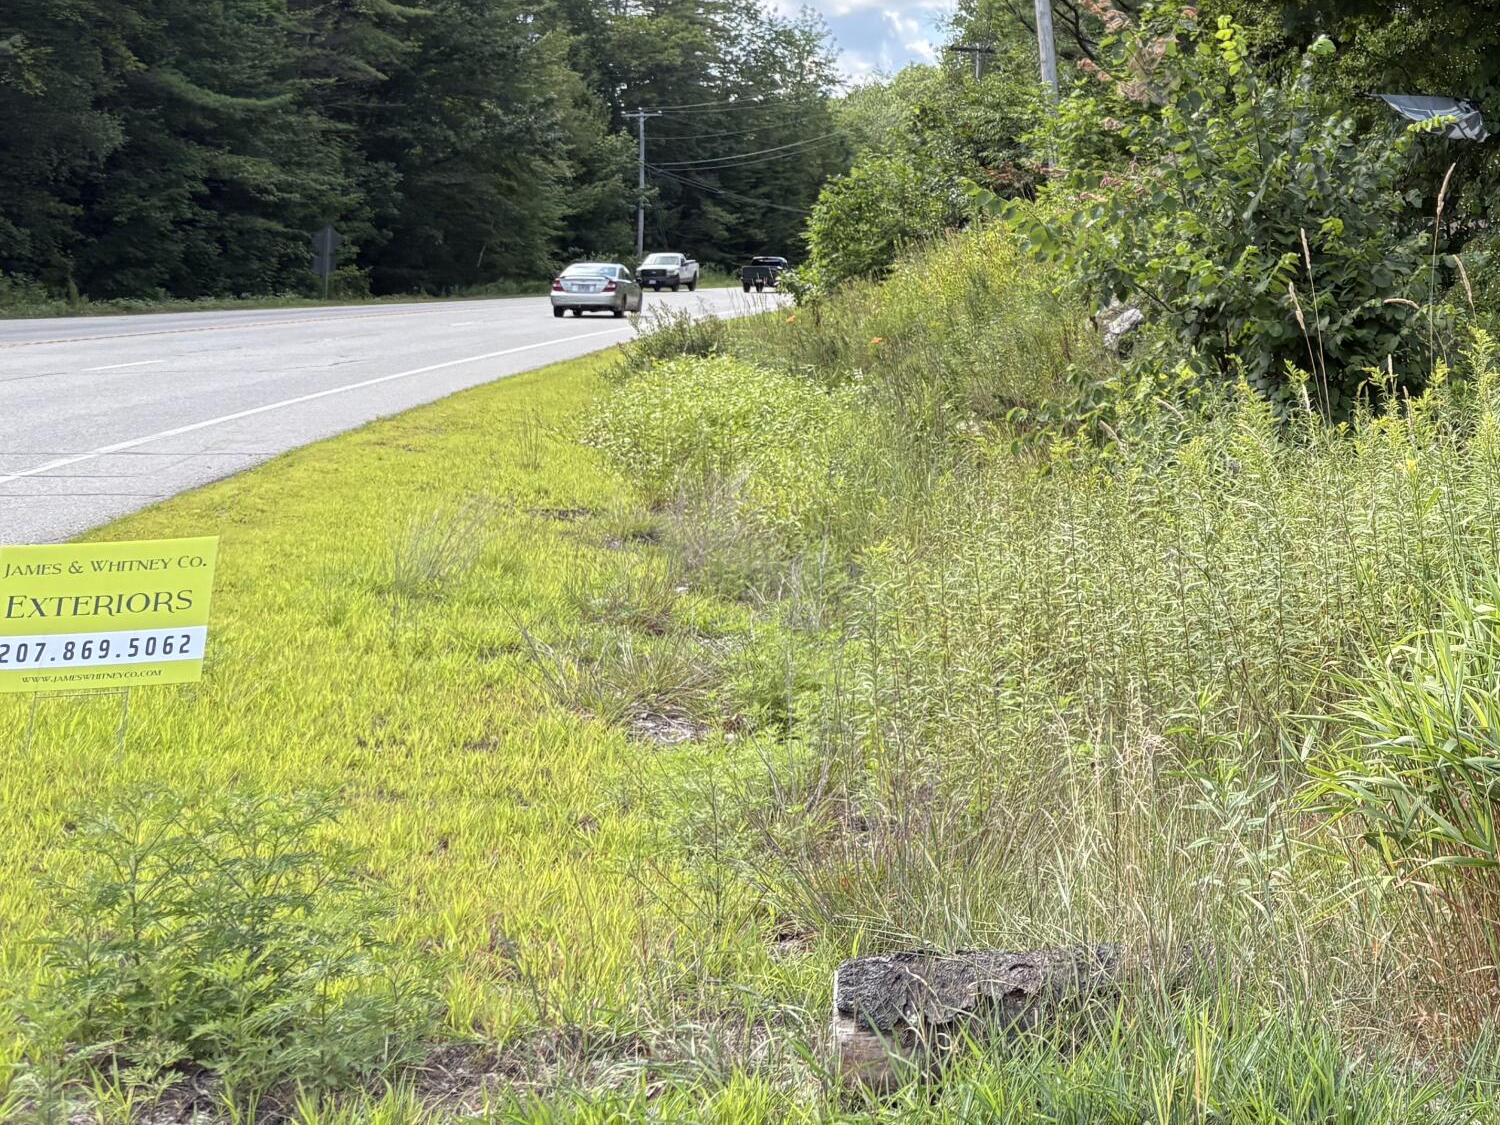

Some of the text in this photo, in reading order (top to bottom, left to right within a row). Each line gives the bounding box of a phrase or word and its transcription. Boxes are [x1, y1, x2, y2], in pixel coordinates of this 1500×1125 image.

[3, 555, 207, 579] JAMES & WHITNEY CO.
[5, 589, 193, 618] EXTERIORS
[0, 634, 191, 663] 207.869.5062
